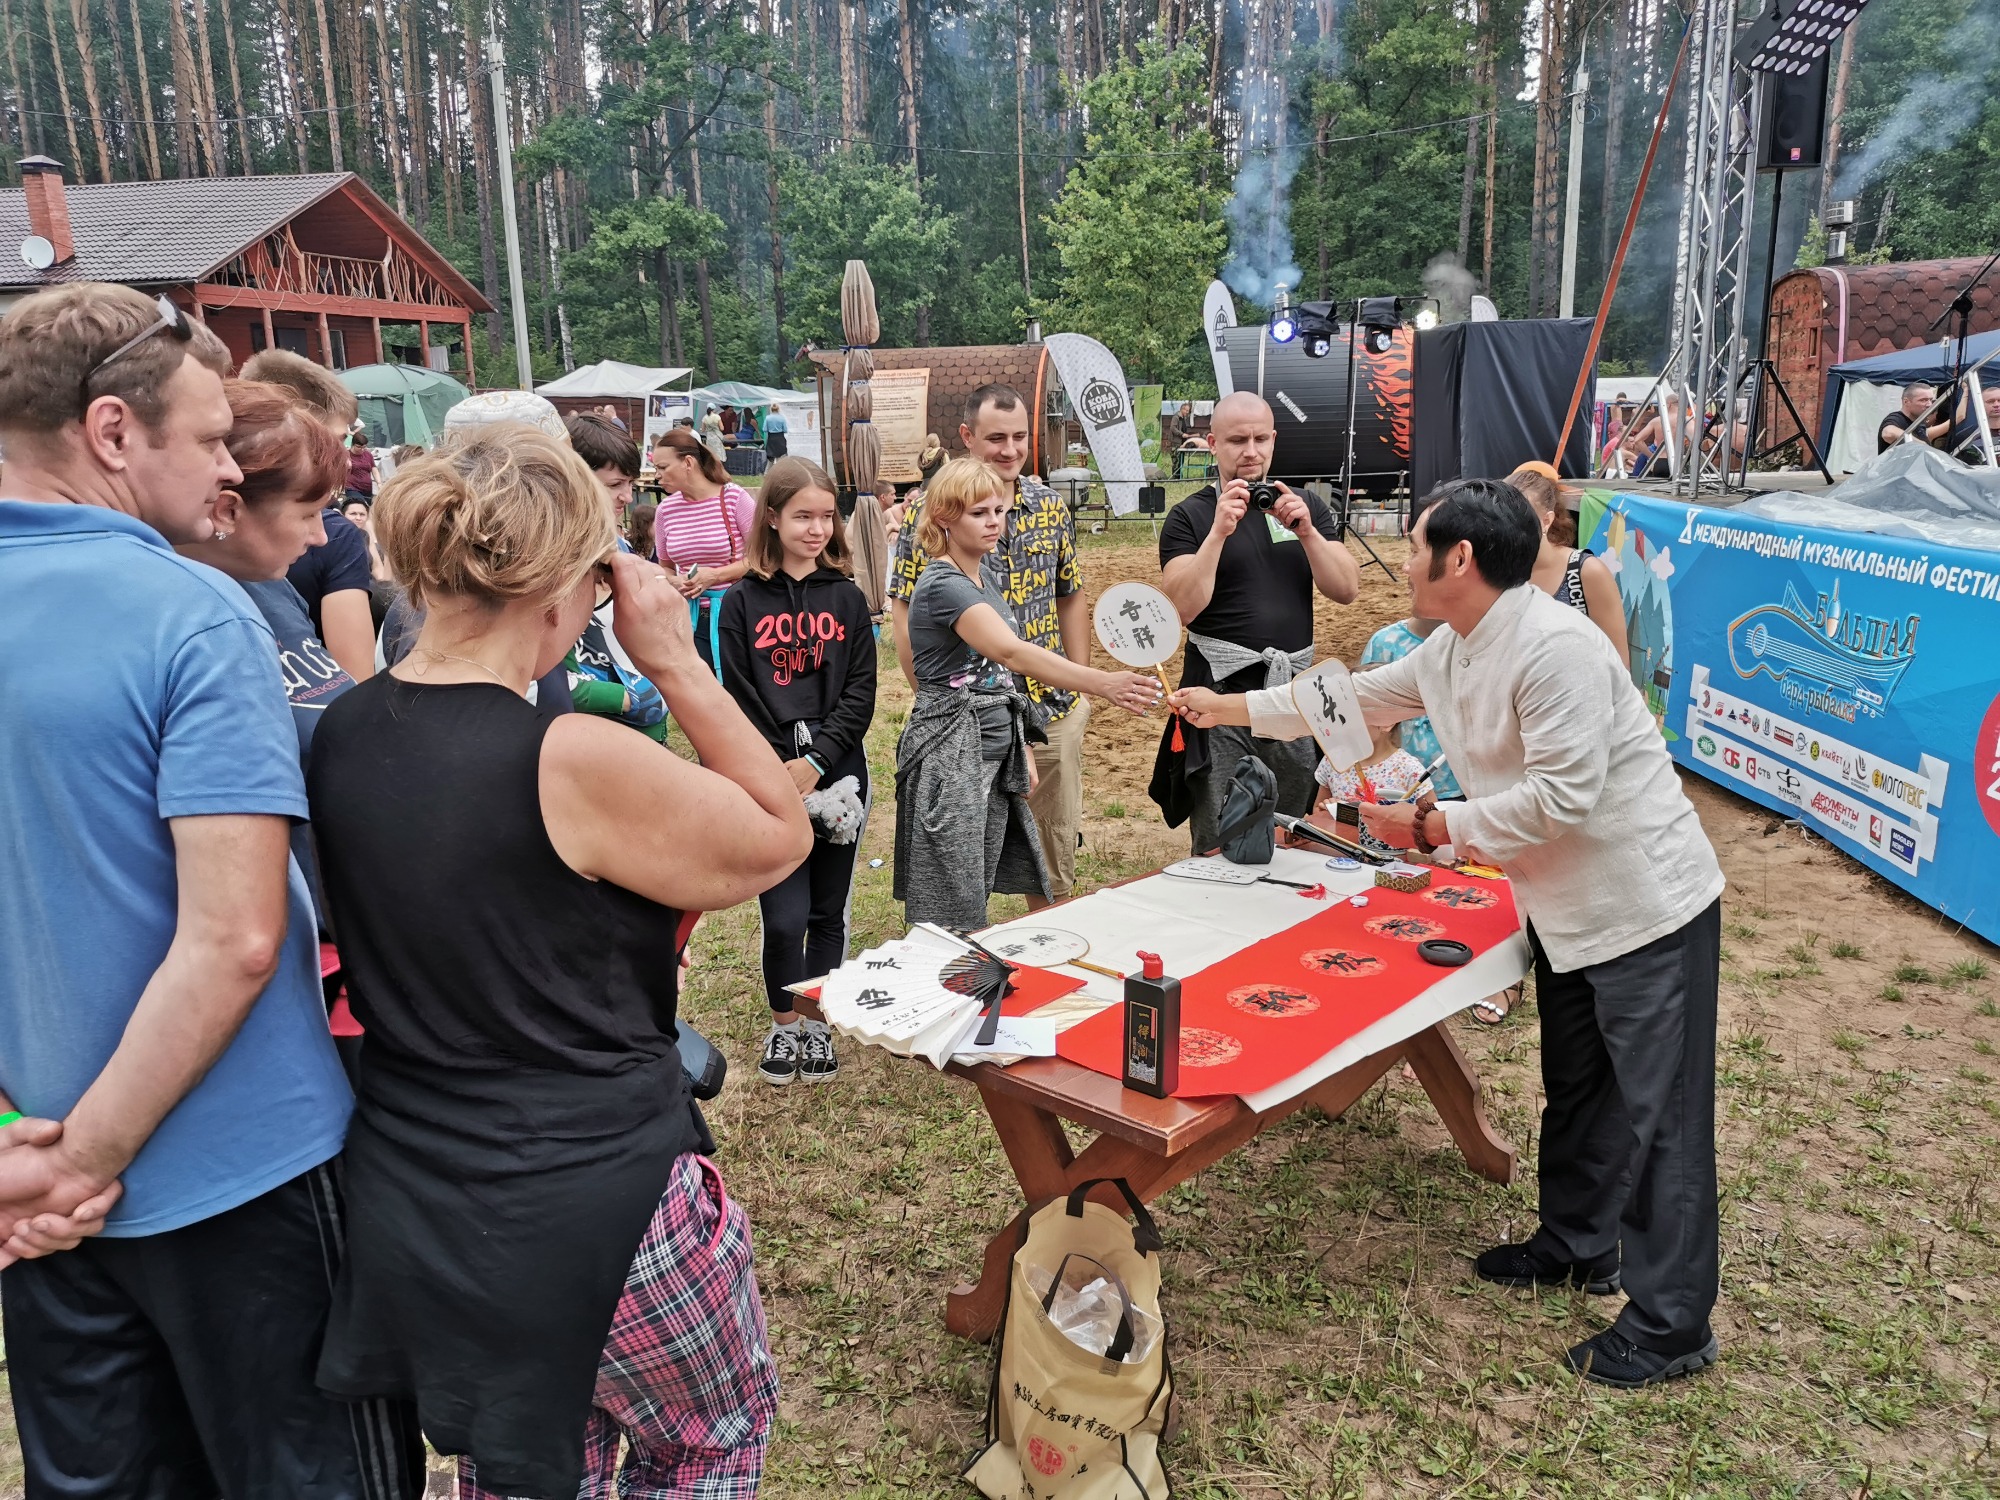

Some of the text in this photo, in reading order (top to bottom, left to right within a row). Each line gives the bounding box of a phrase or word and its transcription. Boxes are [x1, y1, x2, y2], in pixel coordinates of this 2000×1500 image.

[1090, 399, 1119, 415] ГРУПП
[1693, 523, 1804, 561] МЕЖДУНАРОДНЫЙ
[1803, 541, 1928, 585] МУЗЫКАЛЬНЫЙ
[754, 611, 846, 649] 2000's
[771, 639, 824, 686] girl
[290, 673, 350, 702] WEEKEND
[1780, 671, 1857, 724] бард-рыбалка
[1813, 791, 1860, 822] АРГУМЕНТЫ
[1881, 772, 1925, 810] МОГОТЕКС
[1871, 819, 1881, 840] 4
[1892, 832, 1914, 849] MOGILEV
